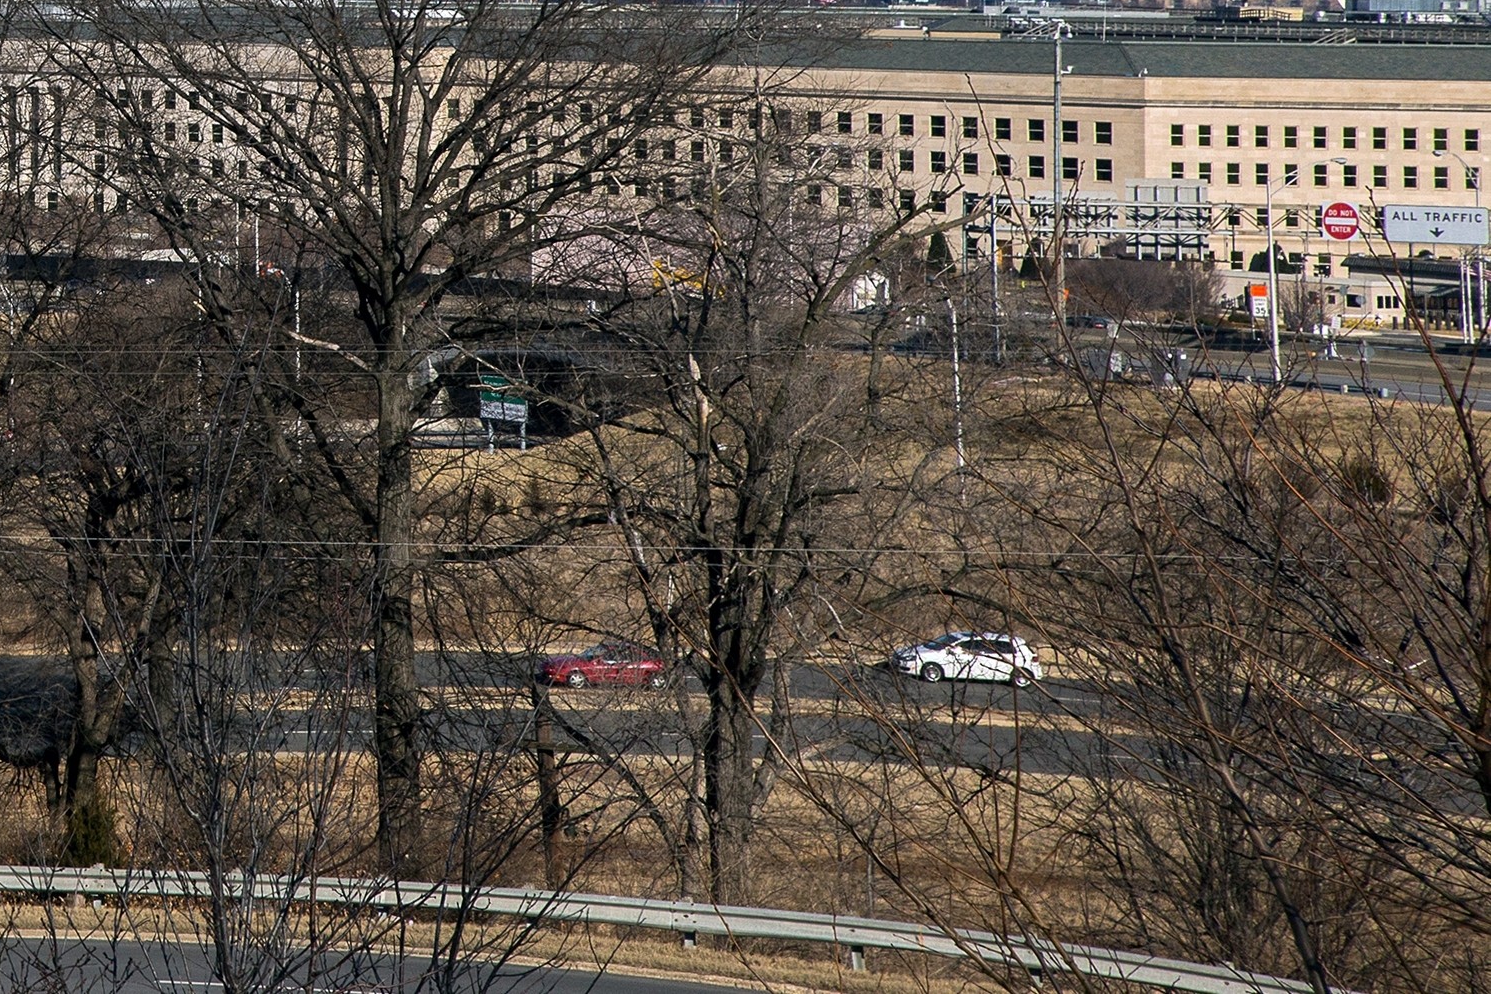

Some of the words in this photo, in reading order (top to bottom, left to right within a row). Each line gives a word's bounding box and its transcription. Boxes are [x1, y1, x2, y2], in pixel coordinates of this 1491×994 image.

[1340, 209, 1354, 217] NOT
[1392, 211, 1418, 221] ALL
[1424, 212, 1482, 223] TRAFFIC
[1331, 225, 1352, 233] ENTER
